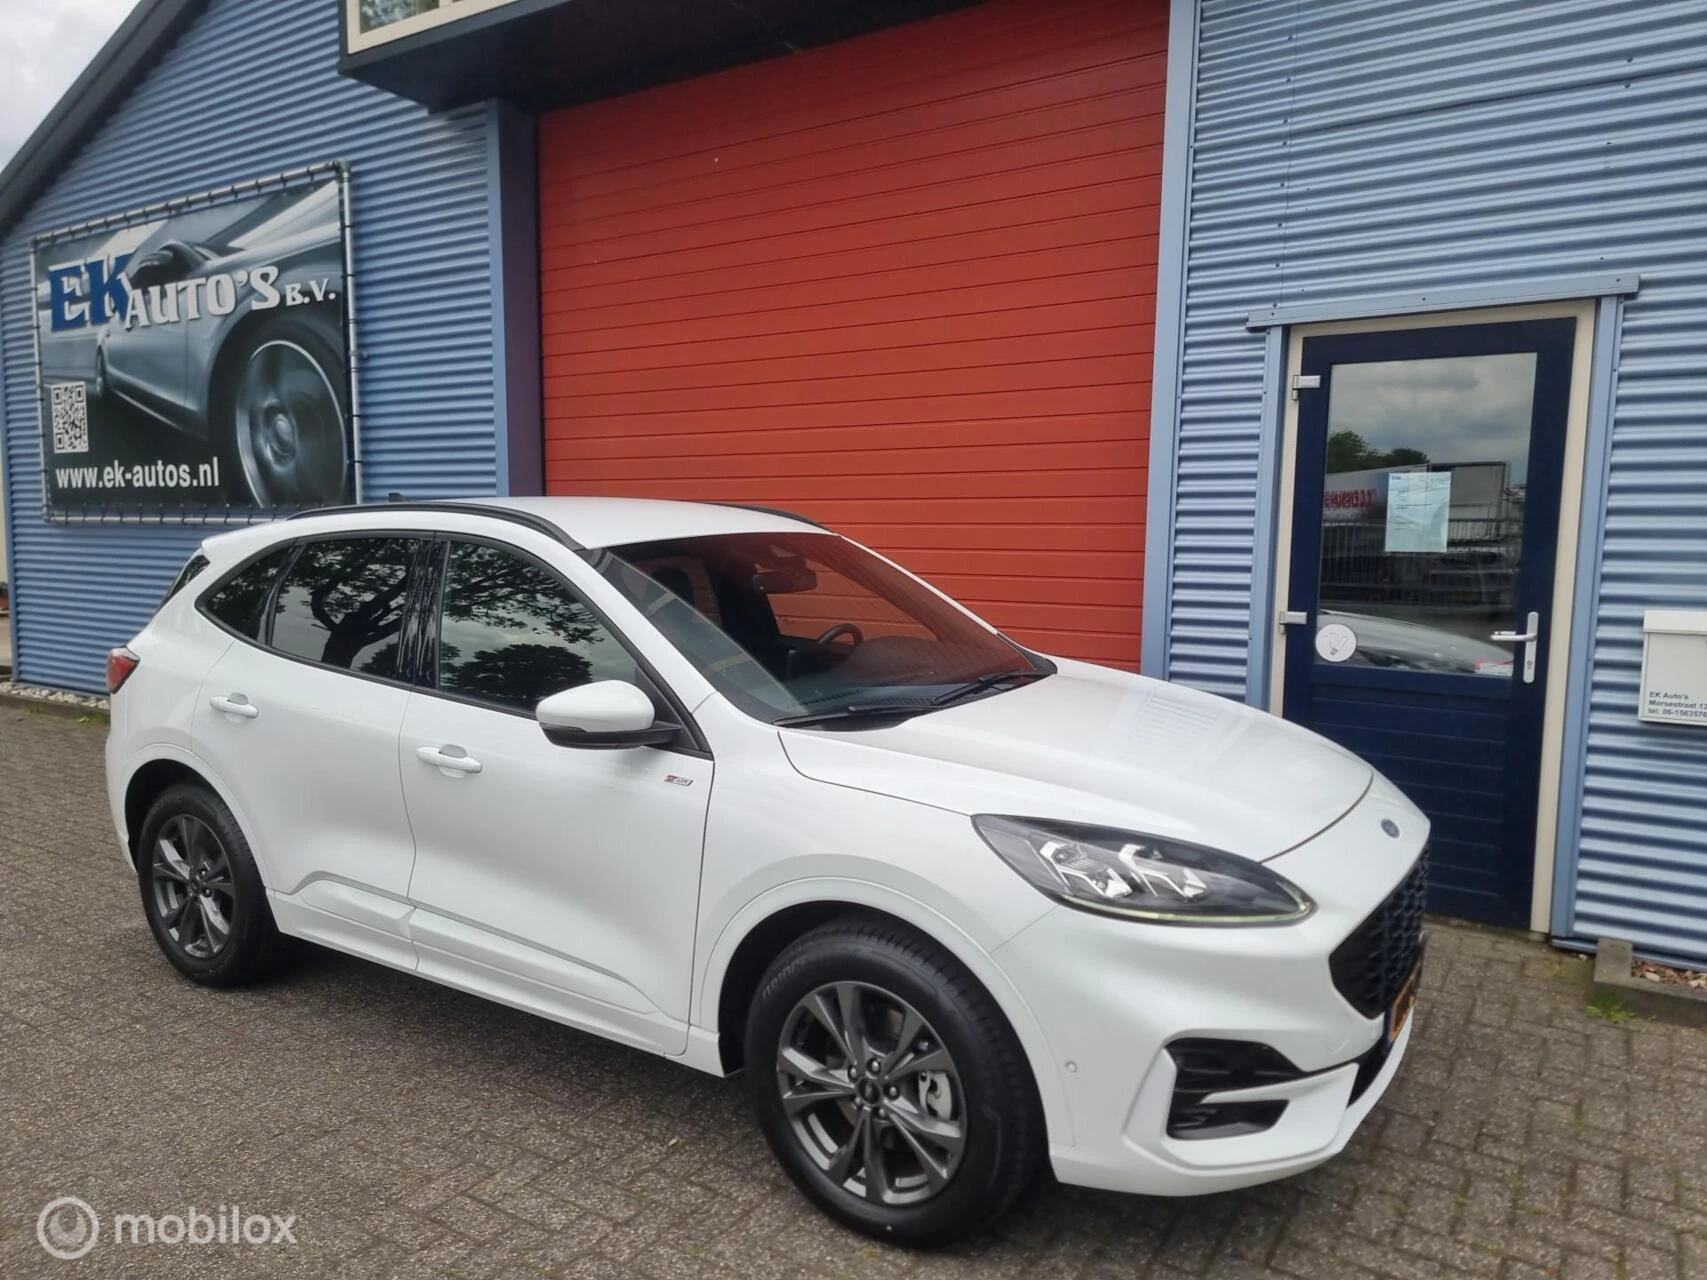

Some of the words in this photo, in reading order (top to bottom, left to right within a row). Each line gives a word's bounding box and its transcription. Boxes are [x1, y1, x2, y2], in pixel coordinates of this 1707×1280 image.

[49, 250, 138, 332] EK
[124, 265, 281, 330] AUTO'S
[285, 278, 337, 307] B.V.
[55, 456, 220, 489] www.ek-autos.nl
